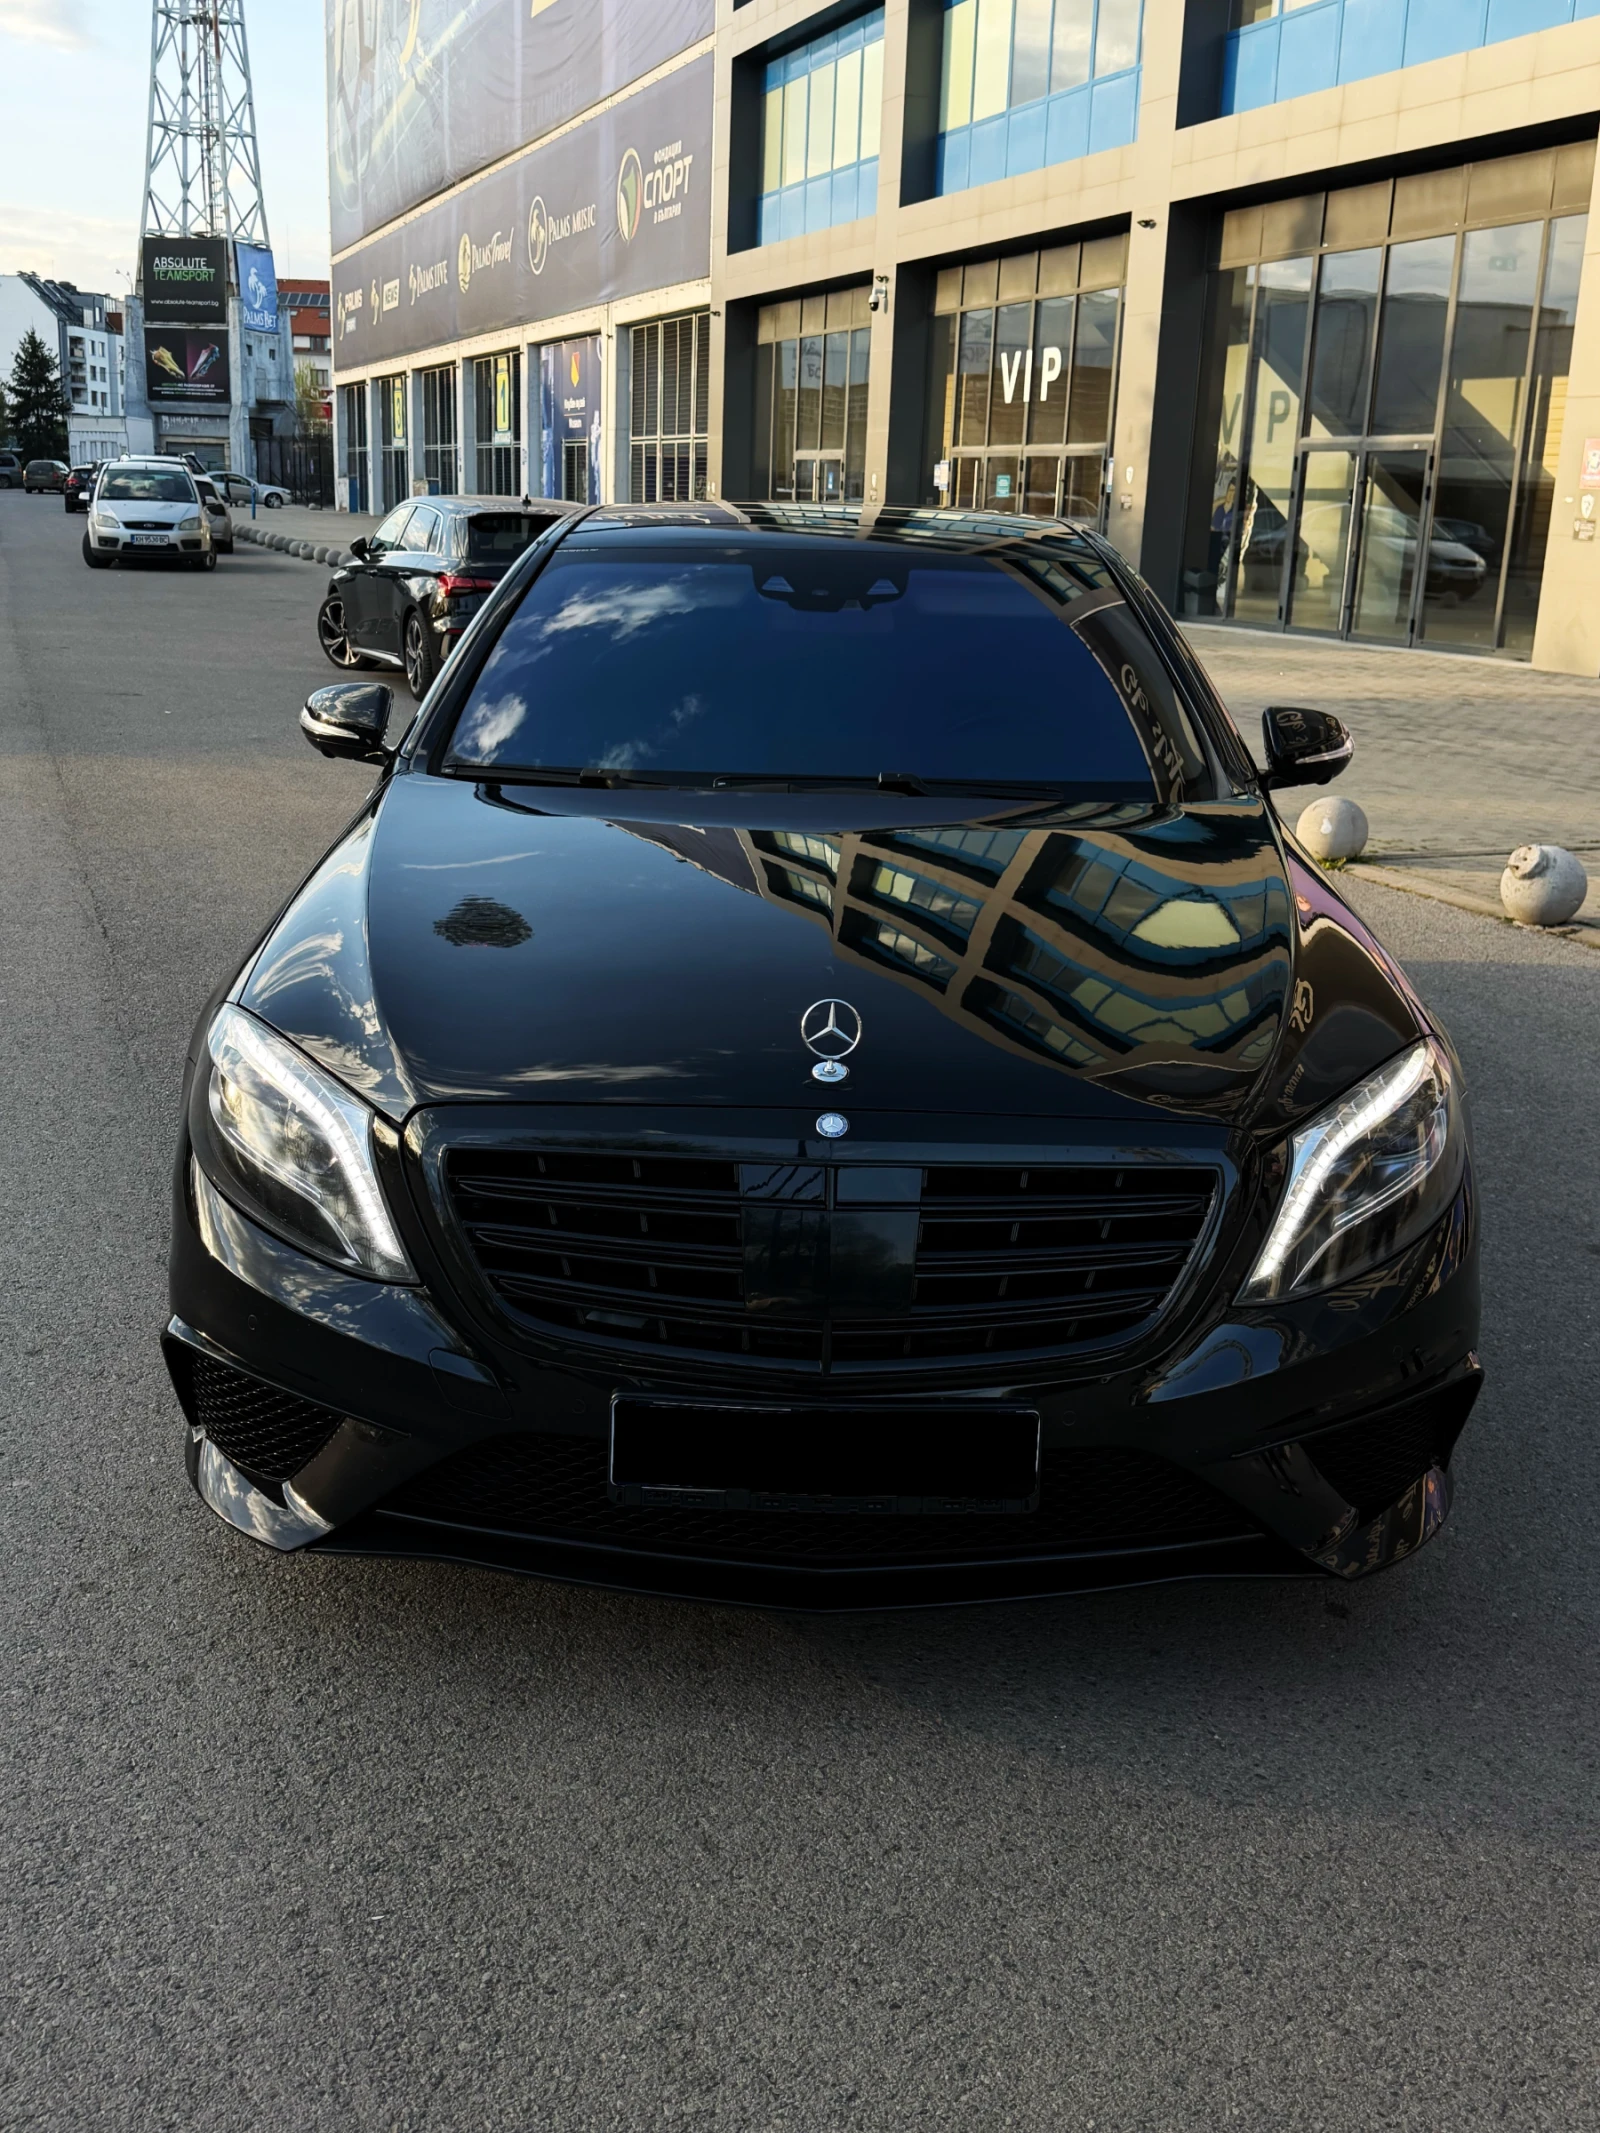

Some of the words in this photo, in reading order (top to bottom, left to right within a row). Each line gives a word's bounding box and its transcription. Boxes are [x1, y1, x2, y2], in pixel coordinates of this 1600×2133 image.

[643, 154, 693, 208] СПОРТ
[548, 215, 570, 245] PALMS
[572, 204, 596, 234] MUSIC
[153, 257, 207, 269] ABSOLUTE
[153, 269, 216, 282] TEAMSPORT
[1000, 347, 1062, 404] VIP
